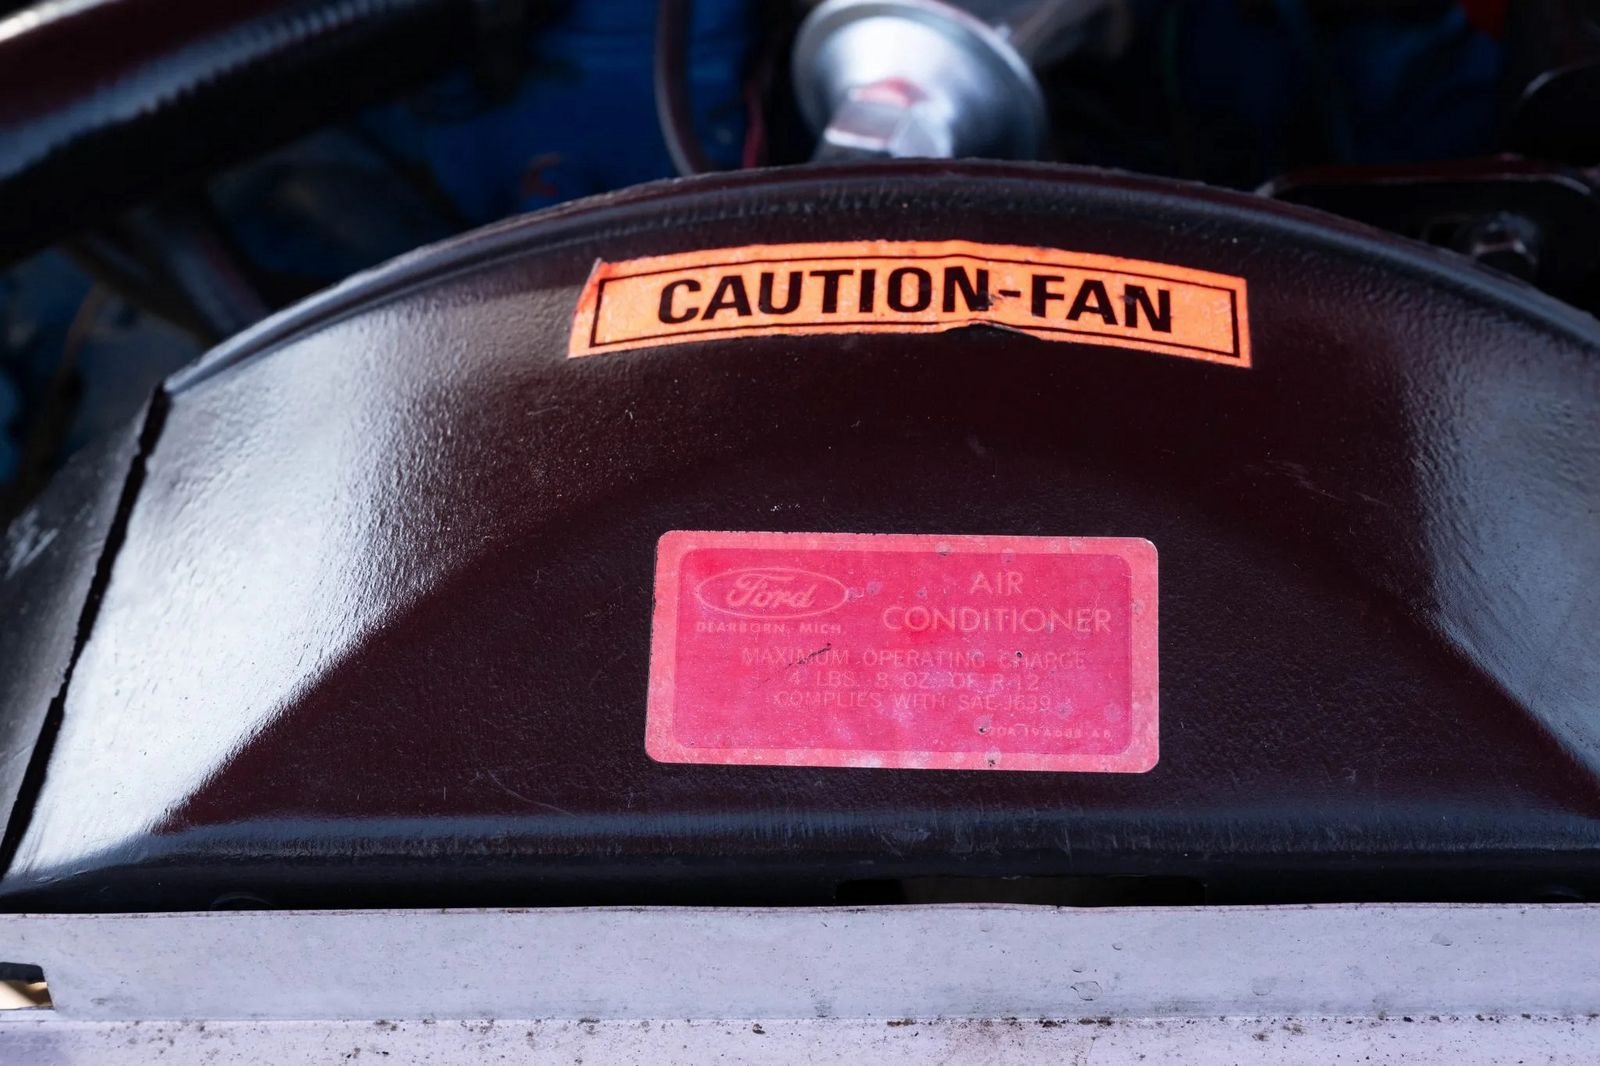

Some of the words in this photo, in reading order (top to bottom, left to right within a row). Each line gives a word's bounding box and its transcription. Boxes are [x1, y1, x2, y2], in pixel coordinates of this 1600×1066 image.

[726, 573, 817, 608] Ford
[969, 570, 1024, 596] AIR
[882, 605, 1112, 633] CONDITIONER
[740, 647, 849, 666] MAXIMUM
[862, 648, 984, 669] OPERATING
[999, 650, 1087, 671] CHARGE
[875, 671, 889, 689] 8
[776, 690, 883, 709] COMPLIES
[893, 692, 946, 711] WITH
